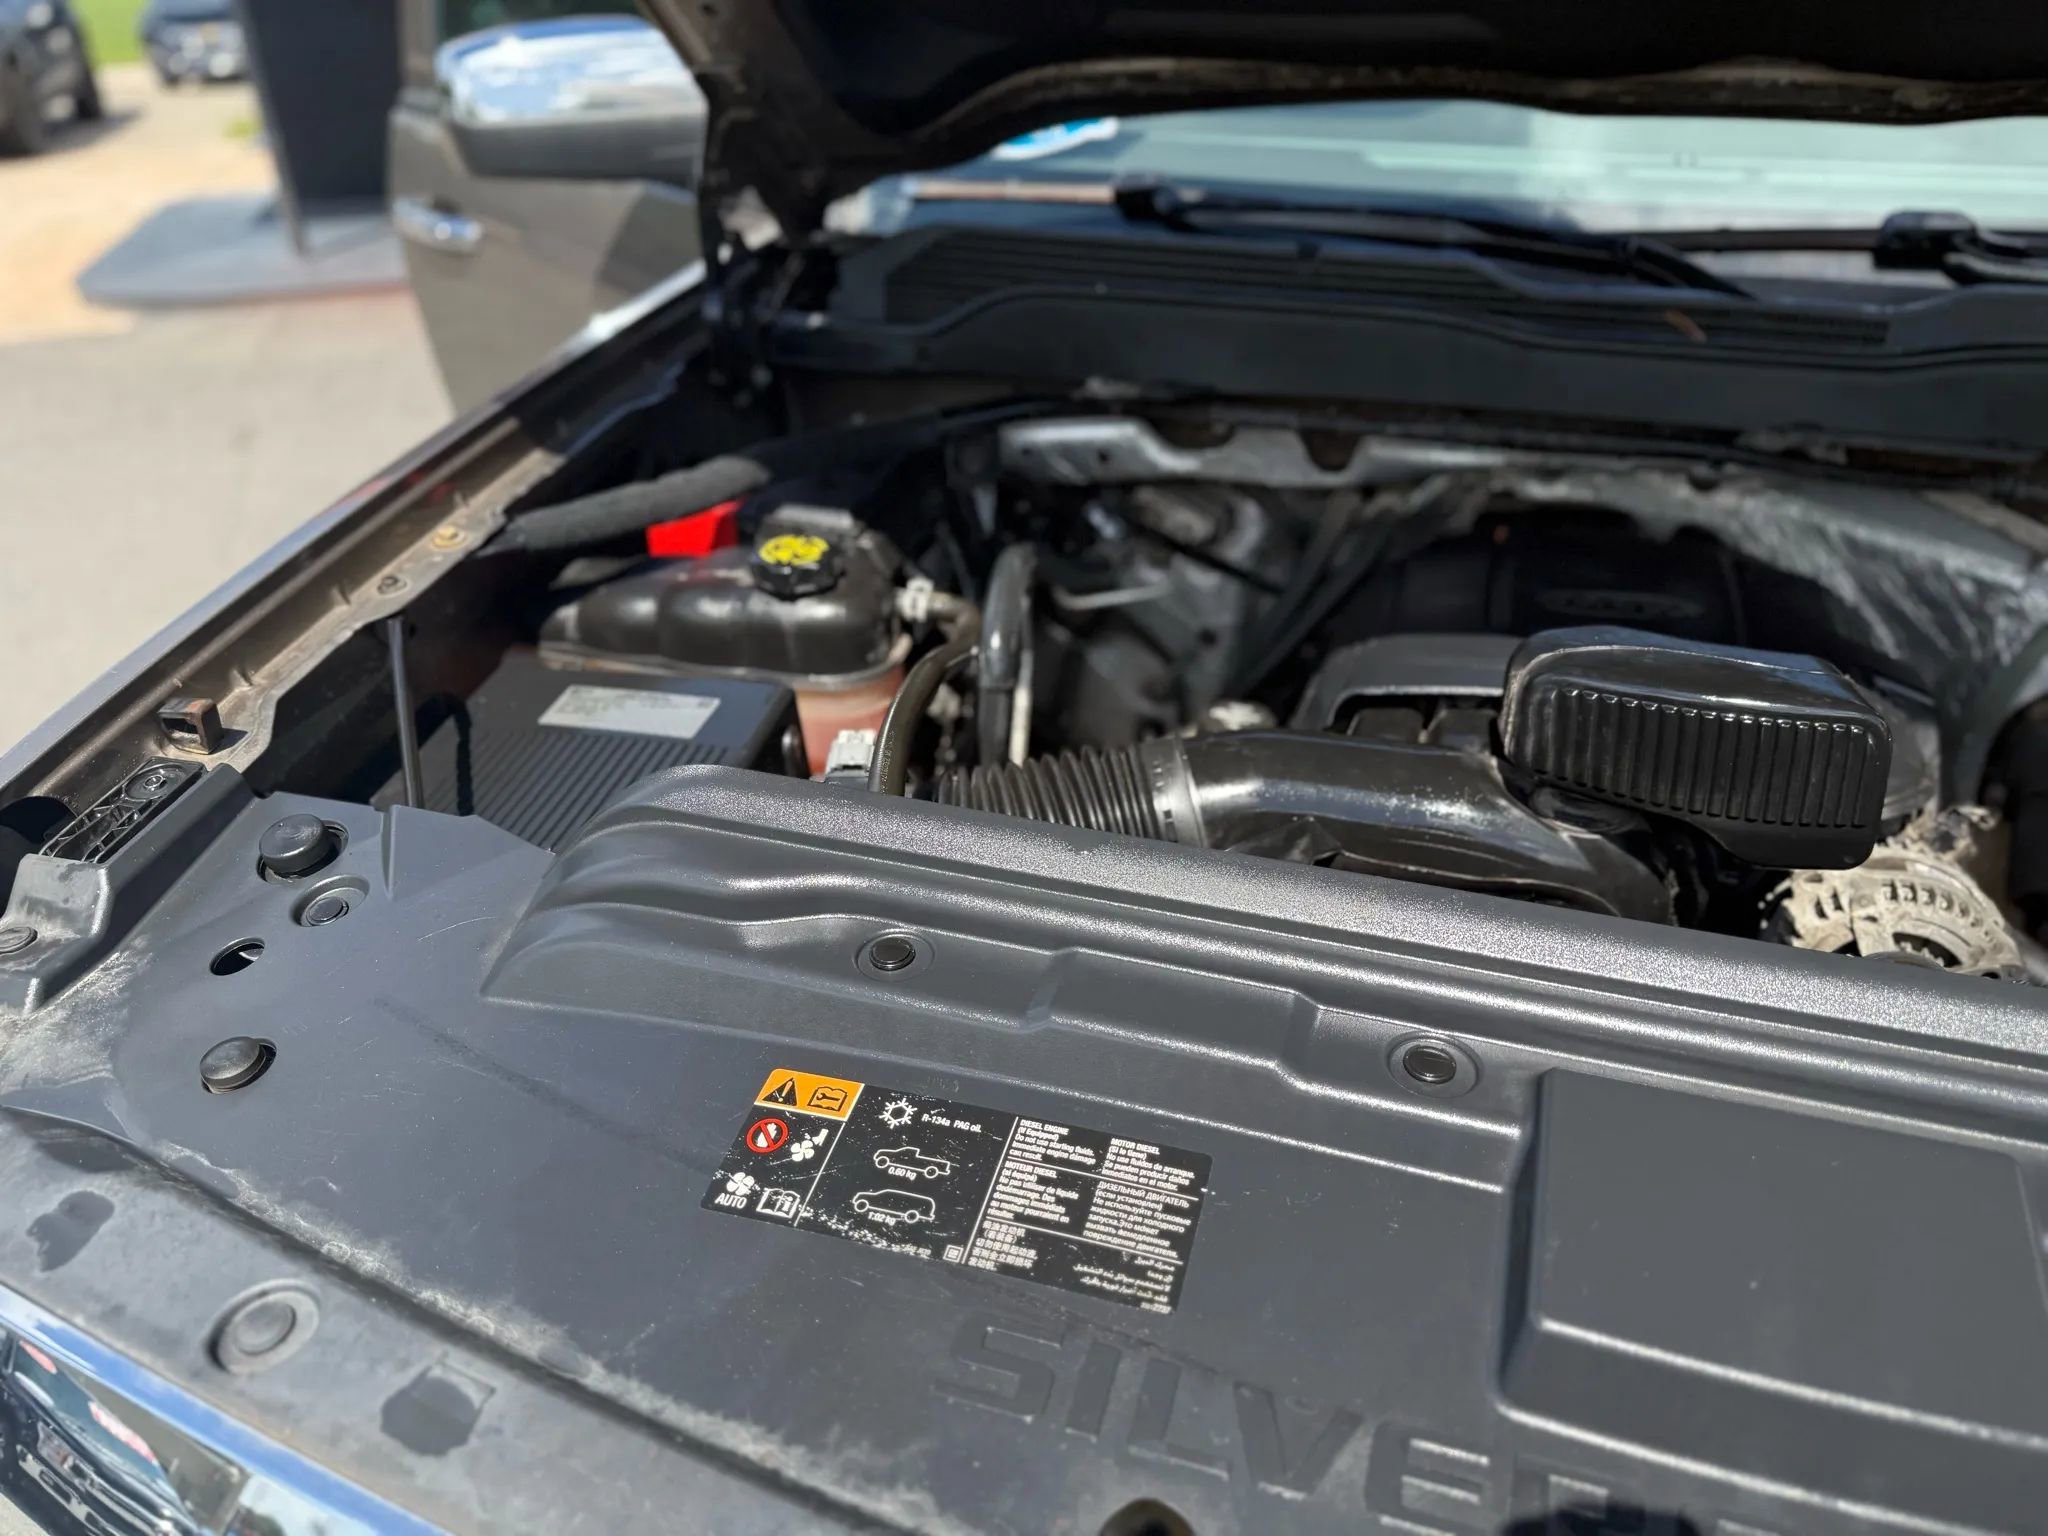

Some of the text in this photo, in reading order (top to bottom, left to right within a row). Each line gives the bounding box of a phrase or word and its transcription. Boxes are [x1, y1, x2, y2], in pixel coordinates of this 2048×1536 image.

[921, 1113, 951, 1127] R-134a
[953, 1119, 971, 1131] PAG
[1020, 1120, 1069, 1135] DIESEL ENGINE
[1049, 1141, 1074, 1153] starting
[1111, 1138, 1159, 1155] MOTOR DIESEL
[1005, 1161, 1057, 1178] MOTEUR DIESEL
[714, 1193, 748, 1209] AUTO
[1098, 1182, 1189, 1208] ДИЗЕЛЬНЫЙ ДВИГАТЕЛЬ
[1117, 1195, 1162, 1211] установлен)
[1091, 1206, 1127, 1219] жидкости
[1144, 1219, 1184, 1232] холодного
[1105, 1201, 1152, 1216] используйте
[1154, 1212, 1191, 1225] пусковые
